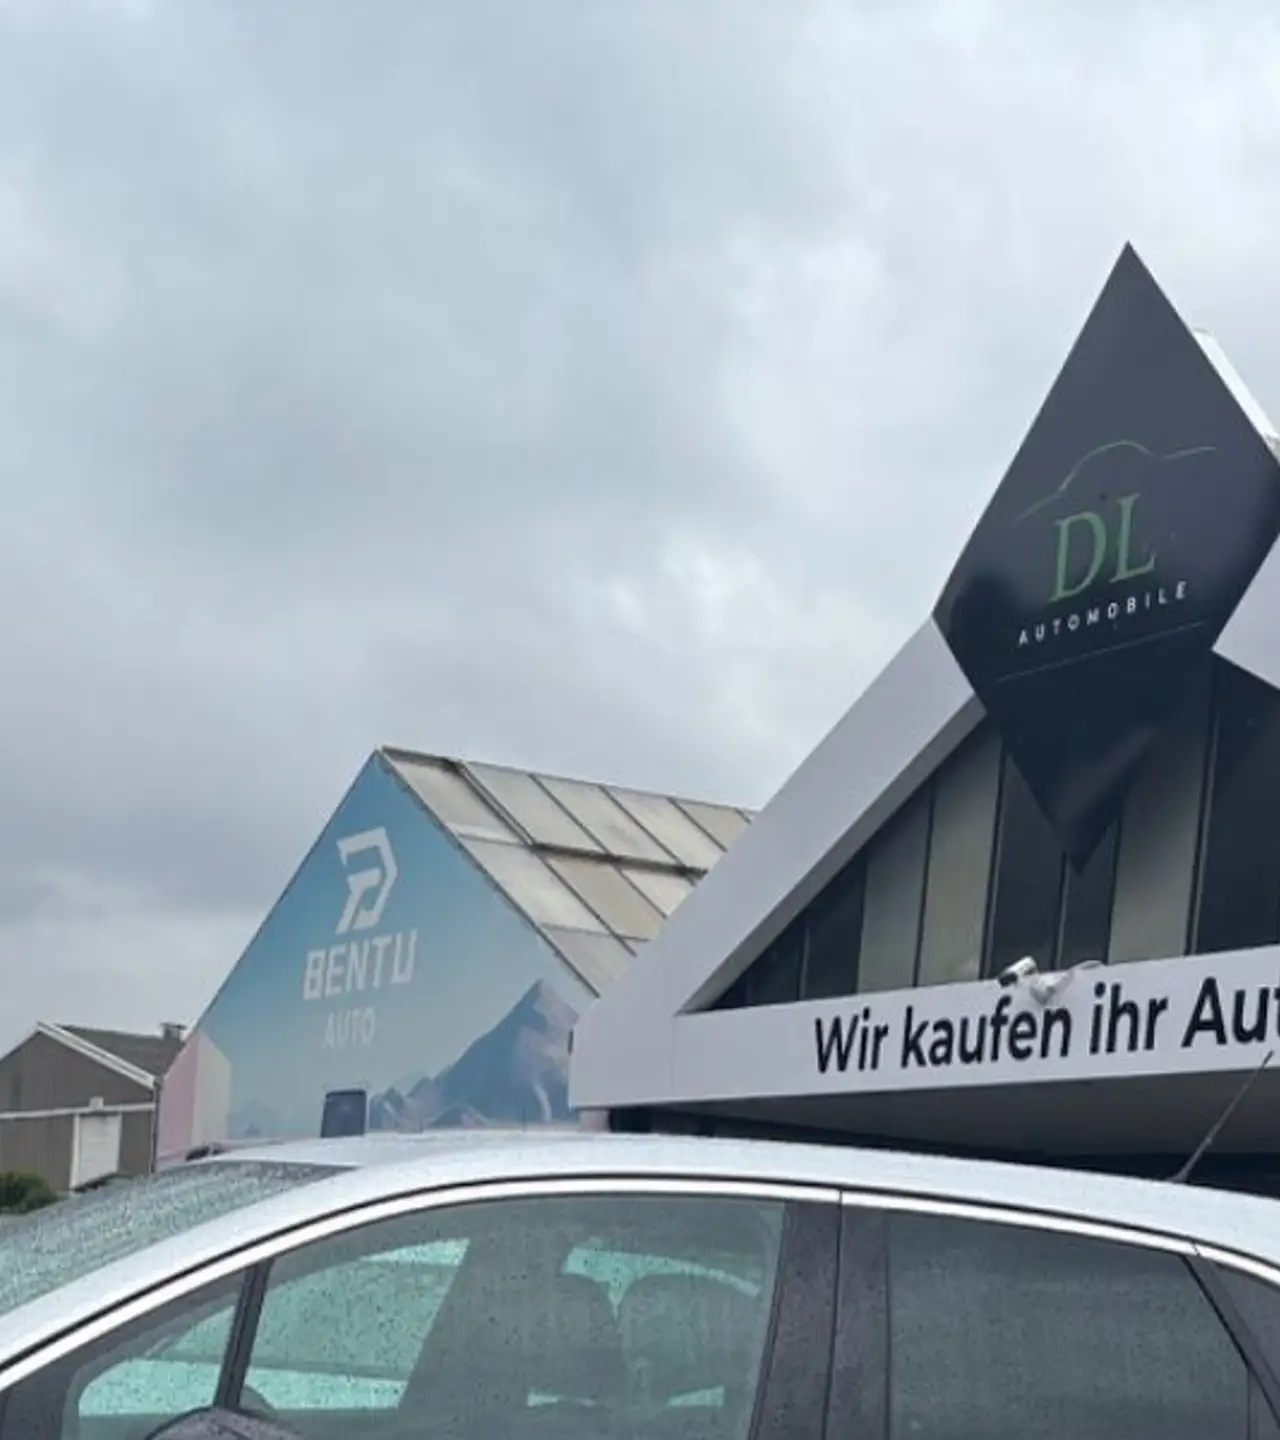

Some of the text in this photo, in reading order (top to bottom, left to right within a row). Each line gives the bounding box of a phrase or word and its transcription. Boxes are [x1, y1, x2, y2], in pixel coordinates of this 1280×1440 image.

[1050, 493, 1156, 601] DL
[1018, 580, 1187, 646] AUTOMOBILE
[303, 929, 418, 1000] BENTU
[322, 1007, 375, 1049] AUTO
[815, 1006, 890, 1074] Wir
[901, 995, 1072, 1068] kaufen
[1089, 981, 1169, 1055] ihr
